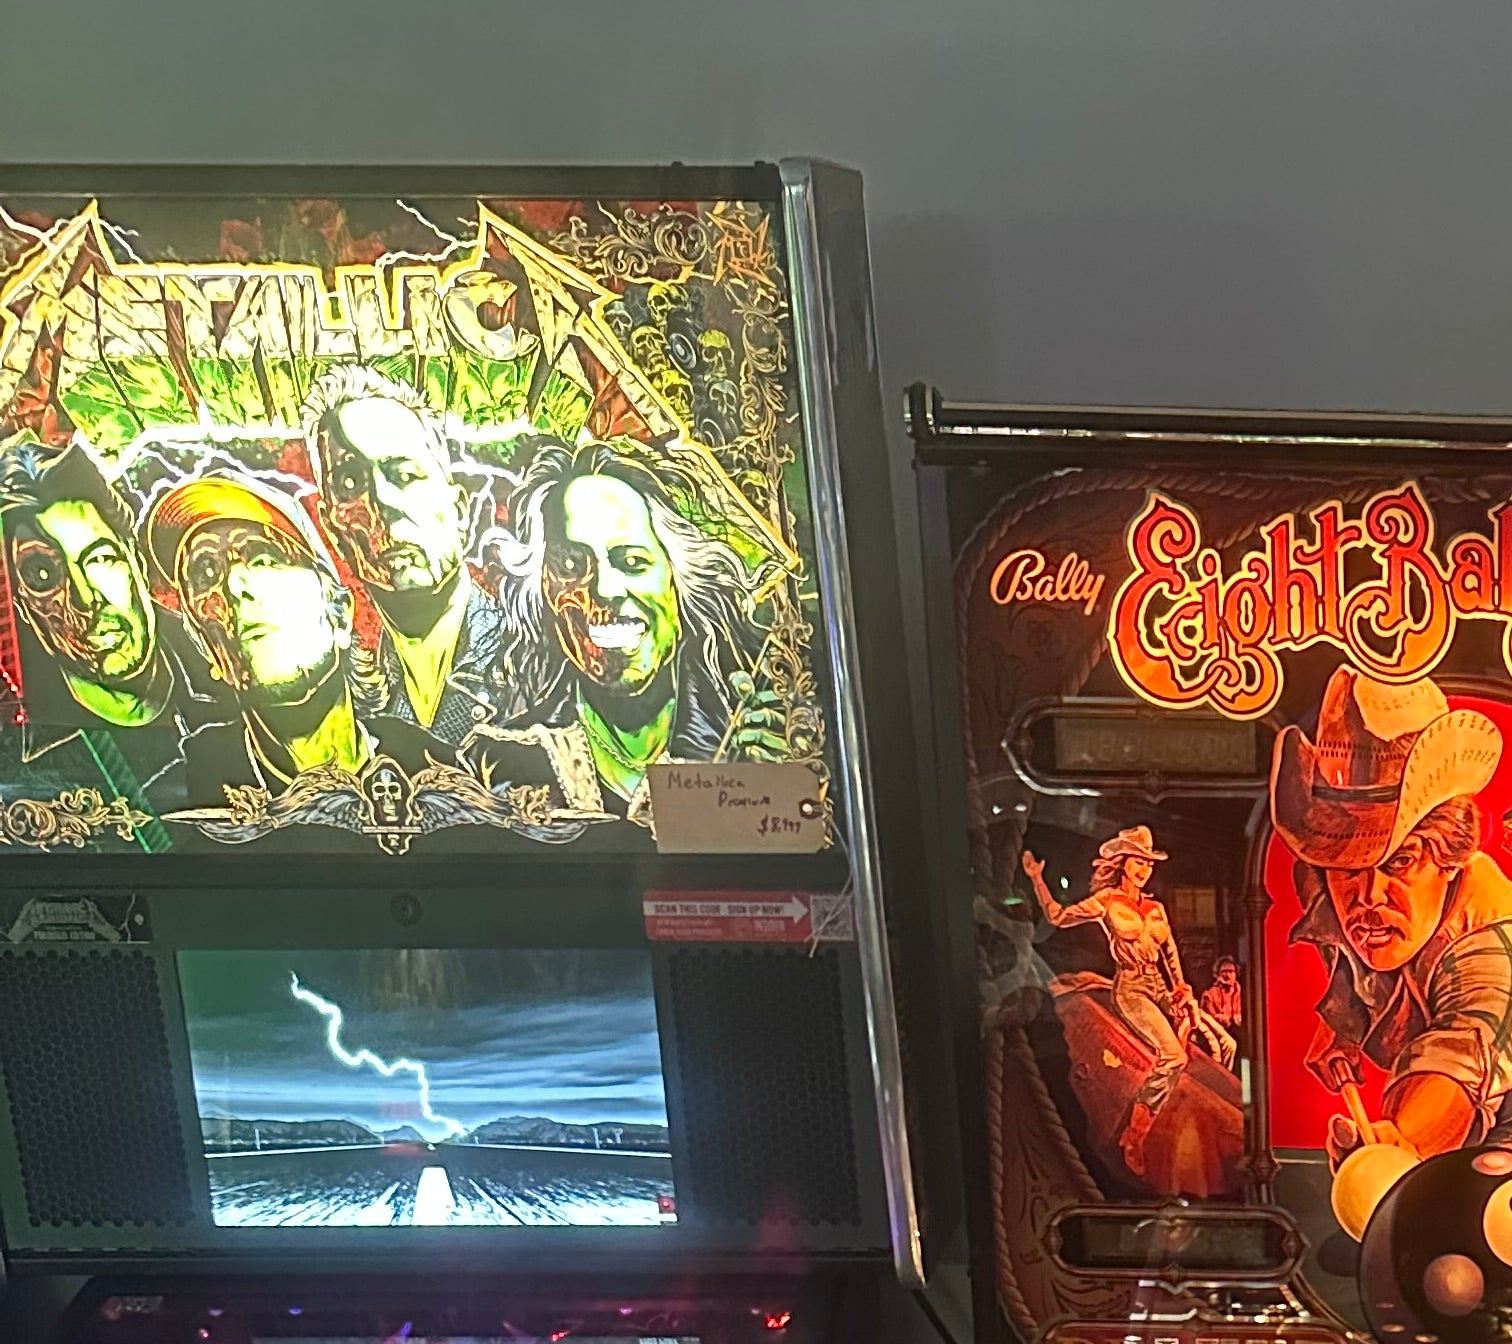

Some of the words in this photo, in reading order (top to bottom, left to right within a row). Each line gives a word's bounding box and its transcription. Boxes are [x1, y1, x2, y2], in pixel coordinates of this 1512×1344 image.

[991, 549, 1105, 615] Bally
[1108, 489, 1363, 720] Eight
[653, 904, 678, 914] SCAN
